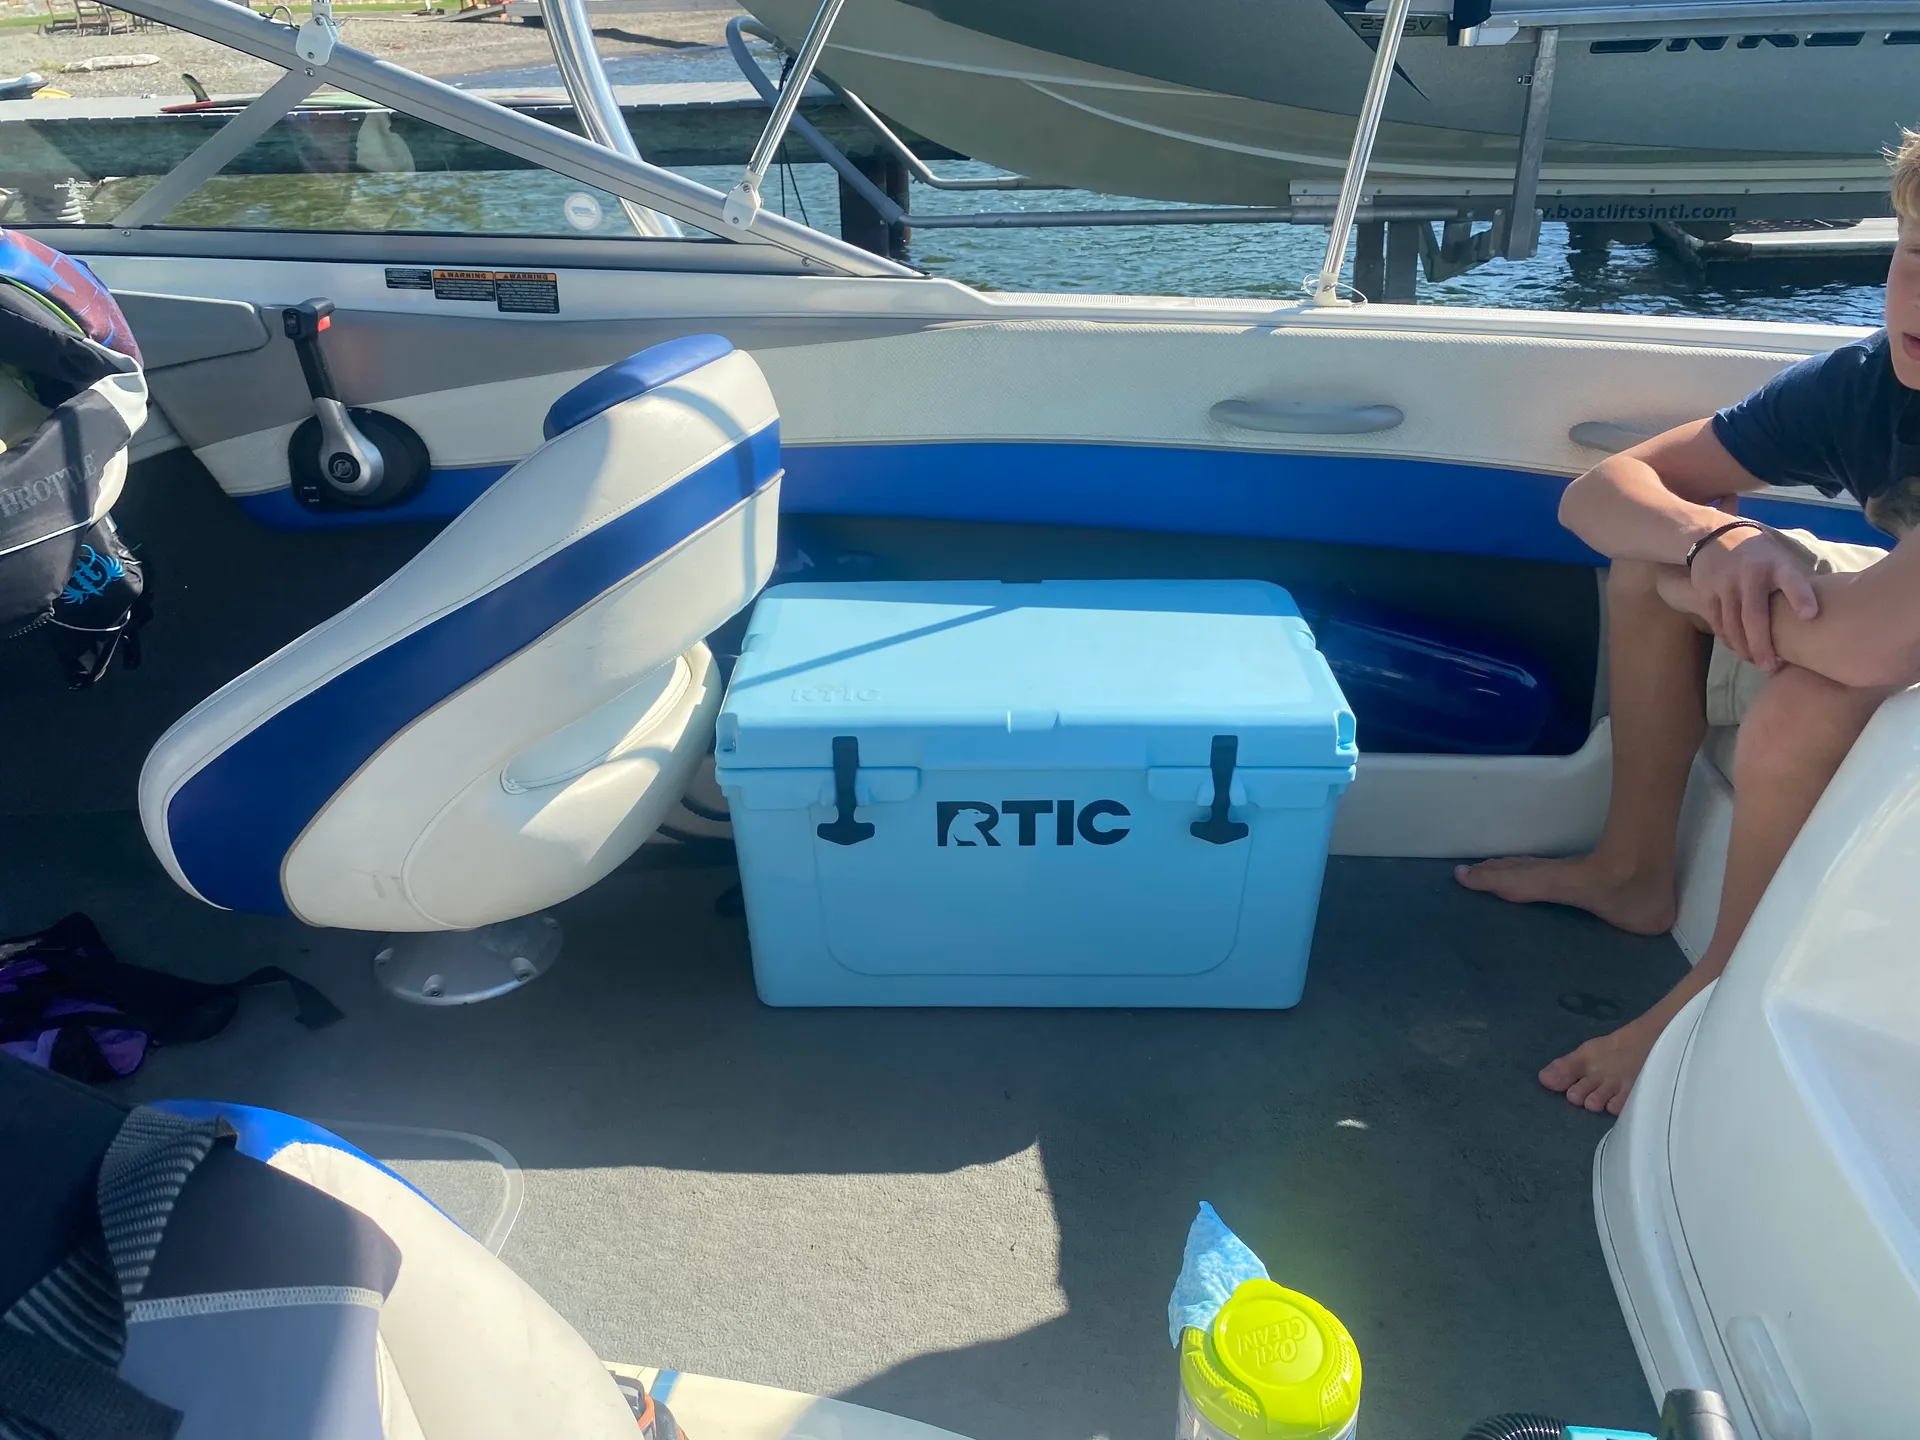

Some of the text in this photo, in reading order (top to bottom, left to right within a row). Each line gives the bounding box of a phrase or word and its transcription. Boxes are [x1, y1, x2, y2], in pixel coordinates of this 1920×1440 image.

[447, 271, 487, 279] WARNING
[507, 273, 548, 281] WARNING
[0, 453, 97, 518] HROTTLE
[937, 799, 1131, 846] RTIC
[1236, 1316, 1306, 1357] CLEAN
[1254, 1338, 1297, 1369] OXI
